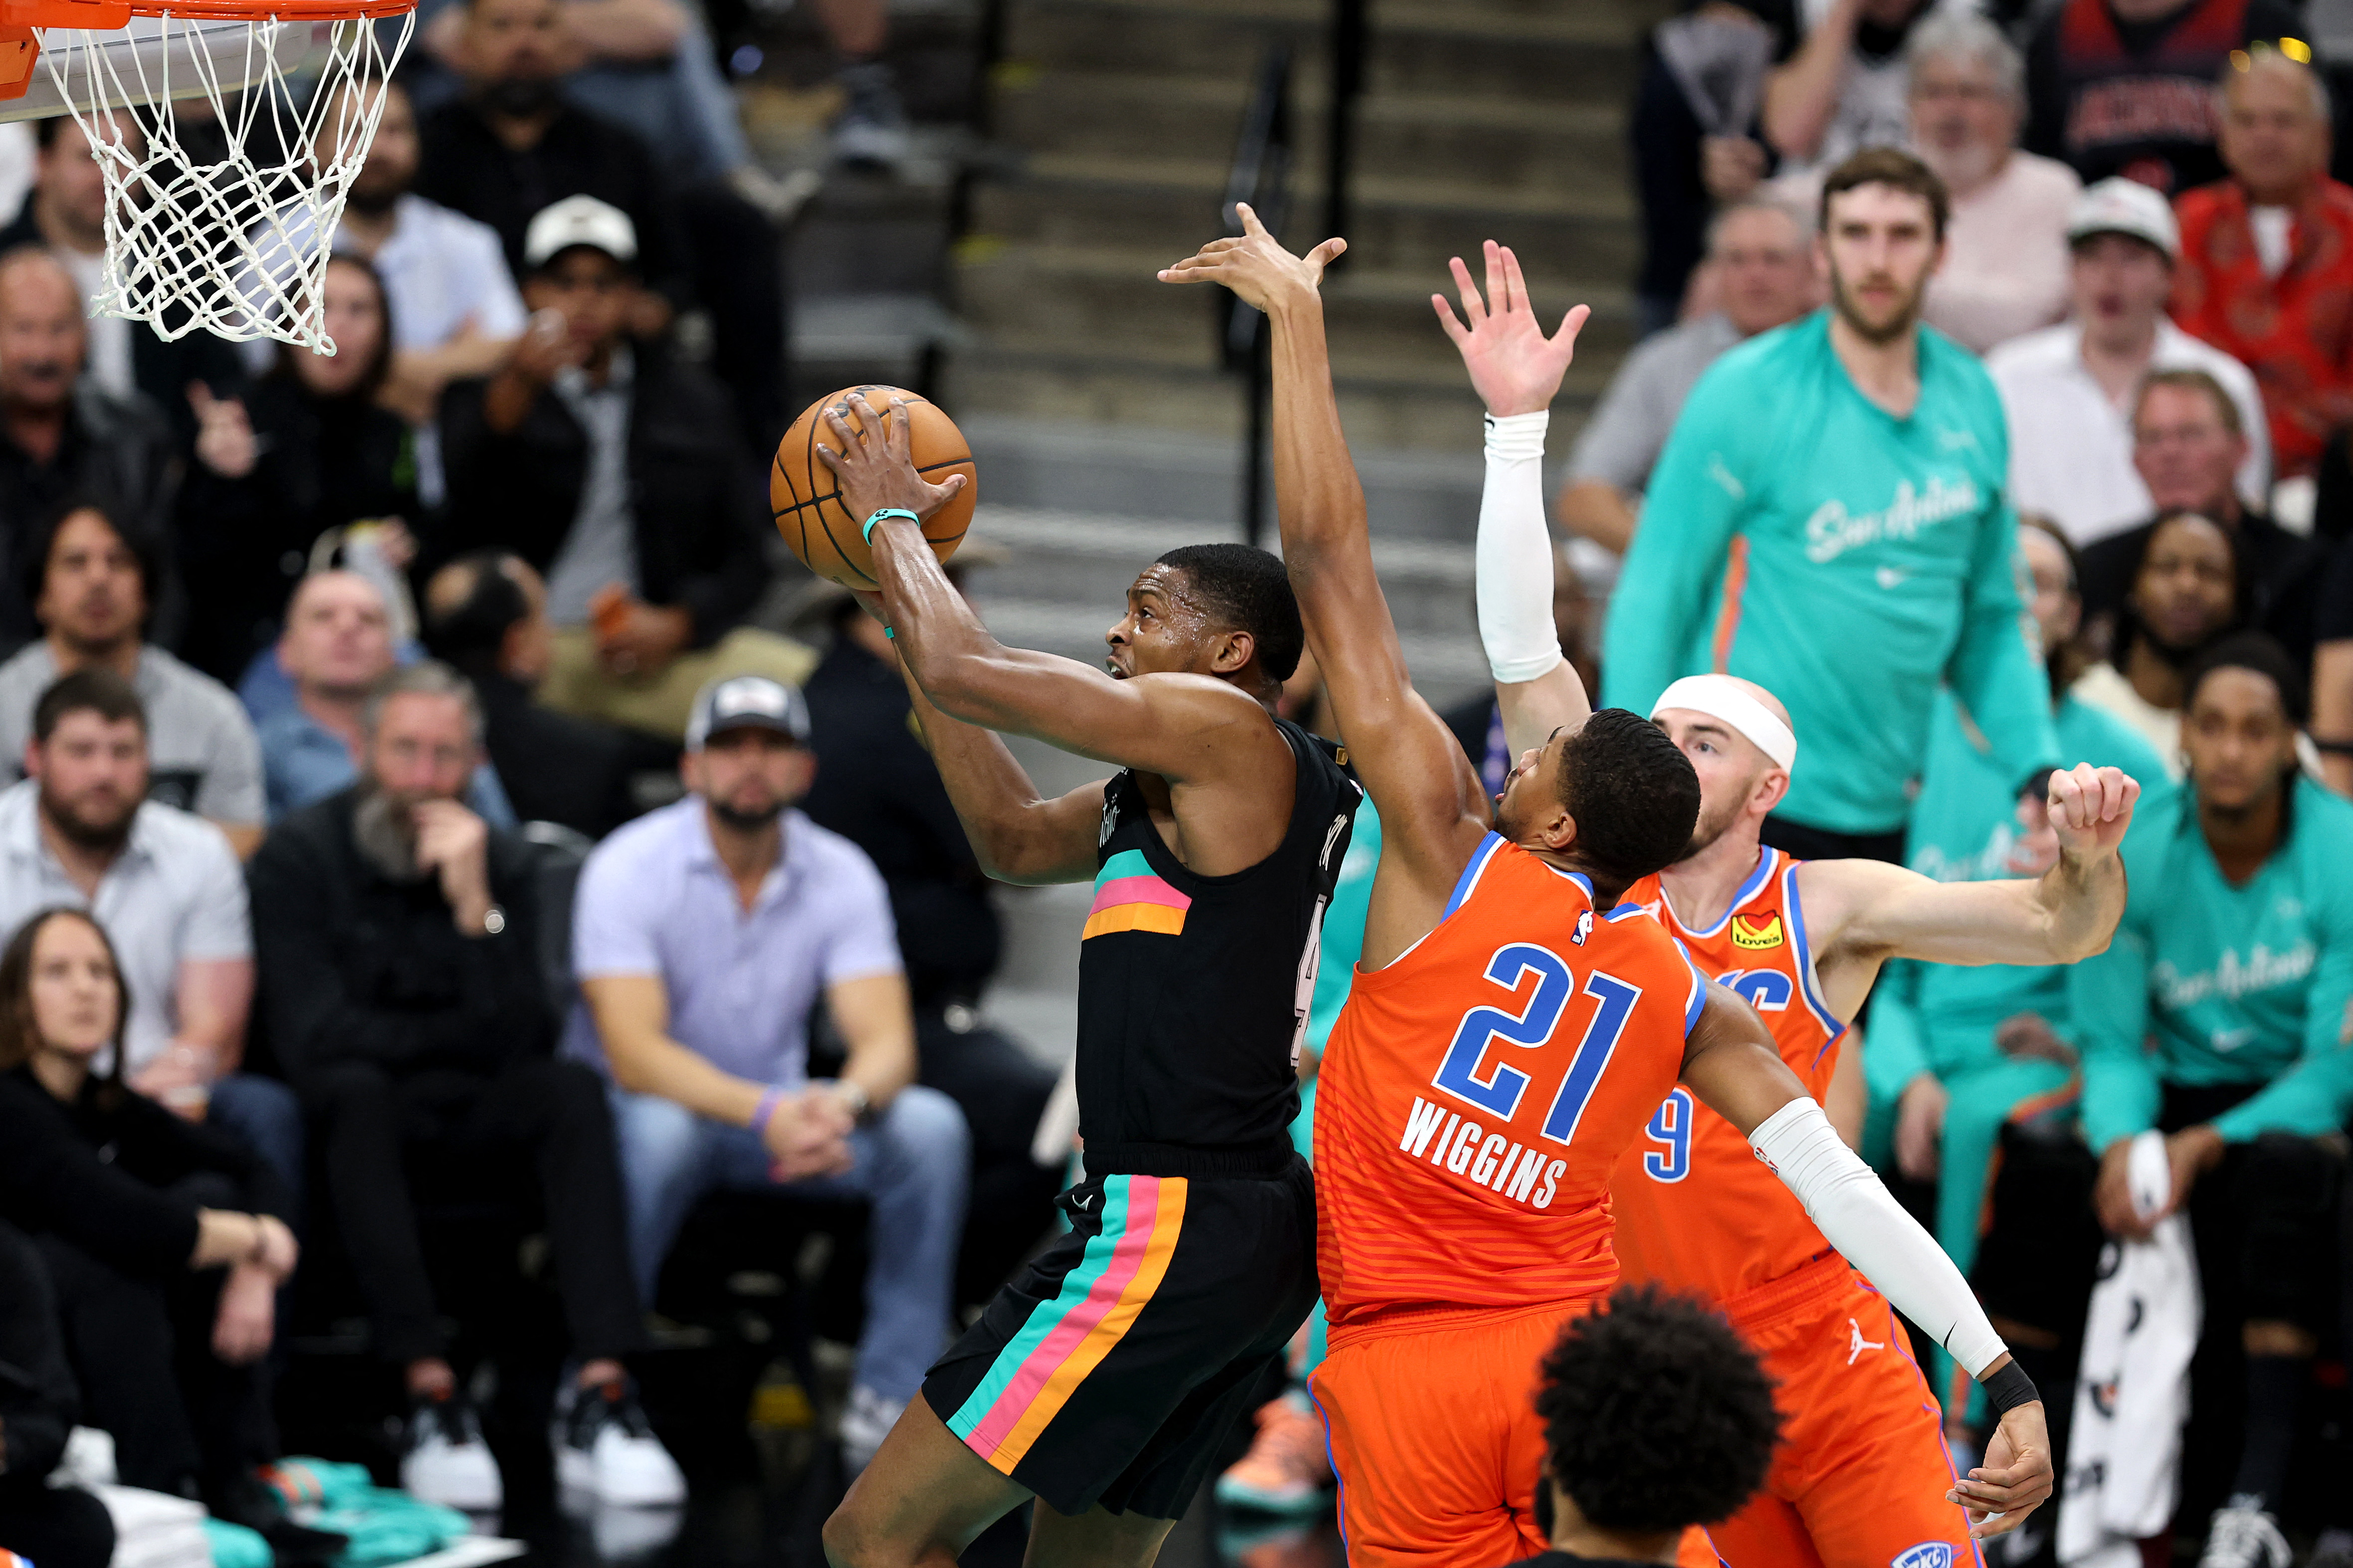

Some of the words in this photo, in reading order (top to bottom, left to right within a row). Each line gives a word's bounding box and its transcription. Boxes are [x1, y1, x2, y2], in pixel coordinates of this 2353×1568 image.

[1571, 934, 1582, 944] NBA
[1431, 942, 1643, 1147] 21
[1399, 1096, 1567, 1209] WIGGINS
[1643, 1087, 1694, 1184] 9
